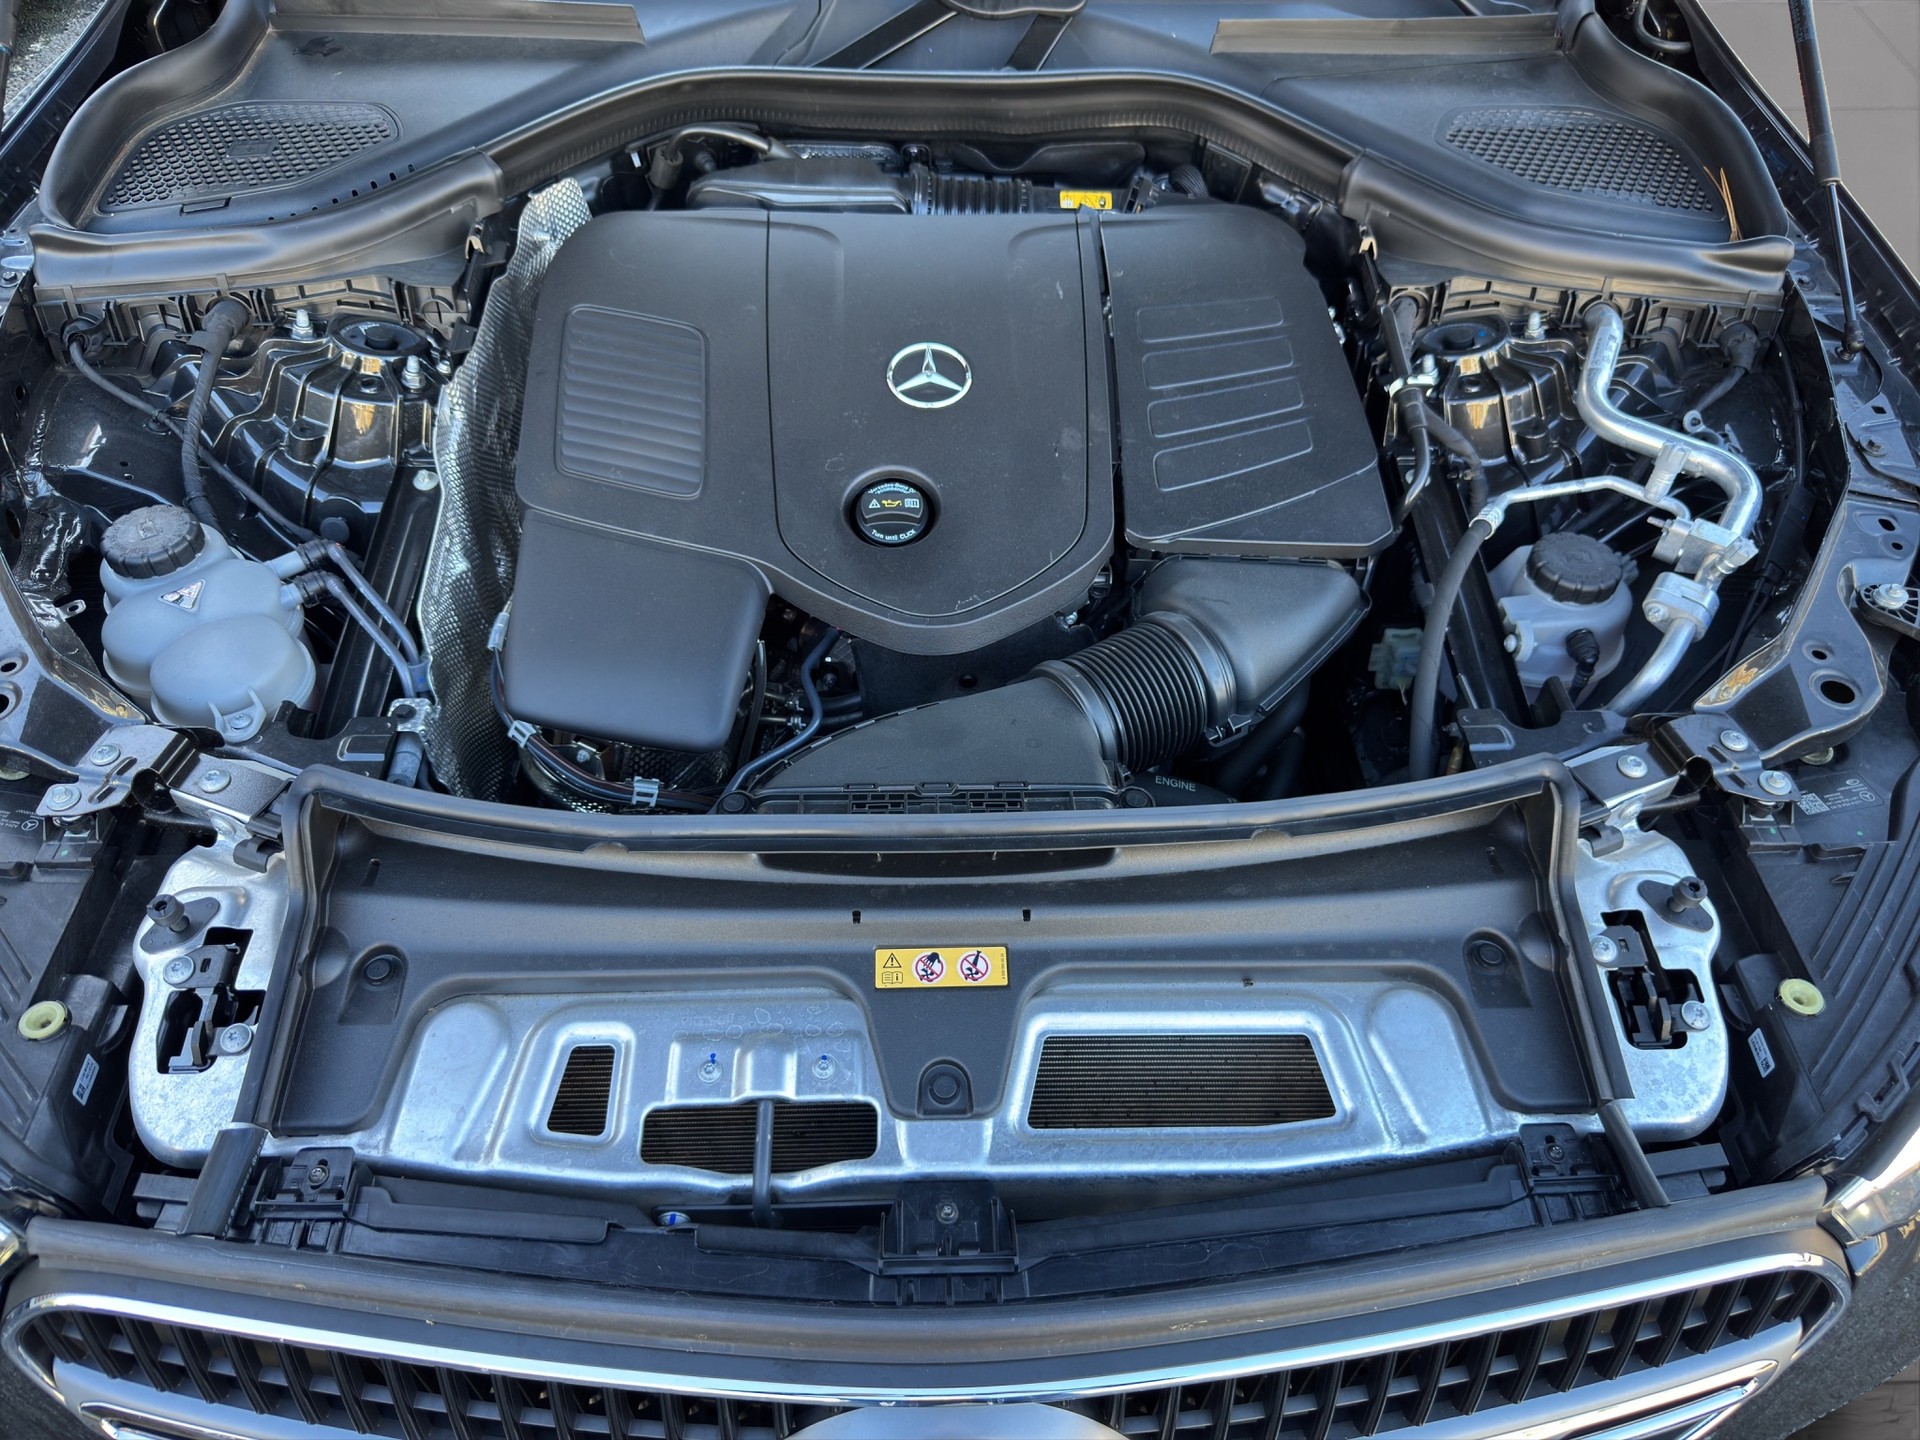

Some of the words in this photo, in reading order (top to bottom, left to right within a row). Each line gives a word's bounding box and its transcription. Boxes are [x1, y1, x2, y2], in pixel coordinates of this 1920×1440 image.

[871, 529, 884, 539] Turn
[899, 528, 917, 540] CLICK
[1155, 775, 1196, 792] ENGINE
